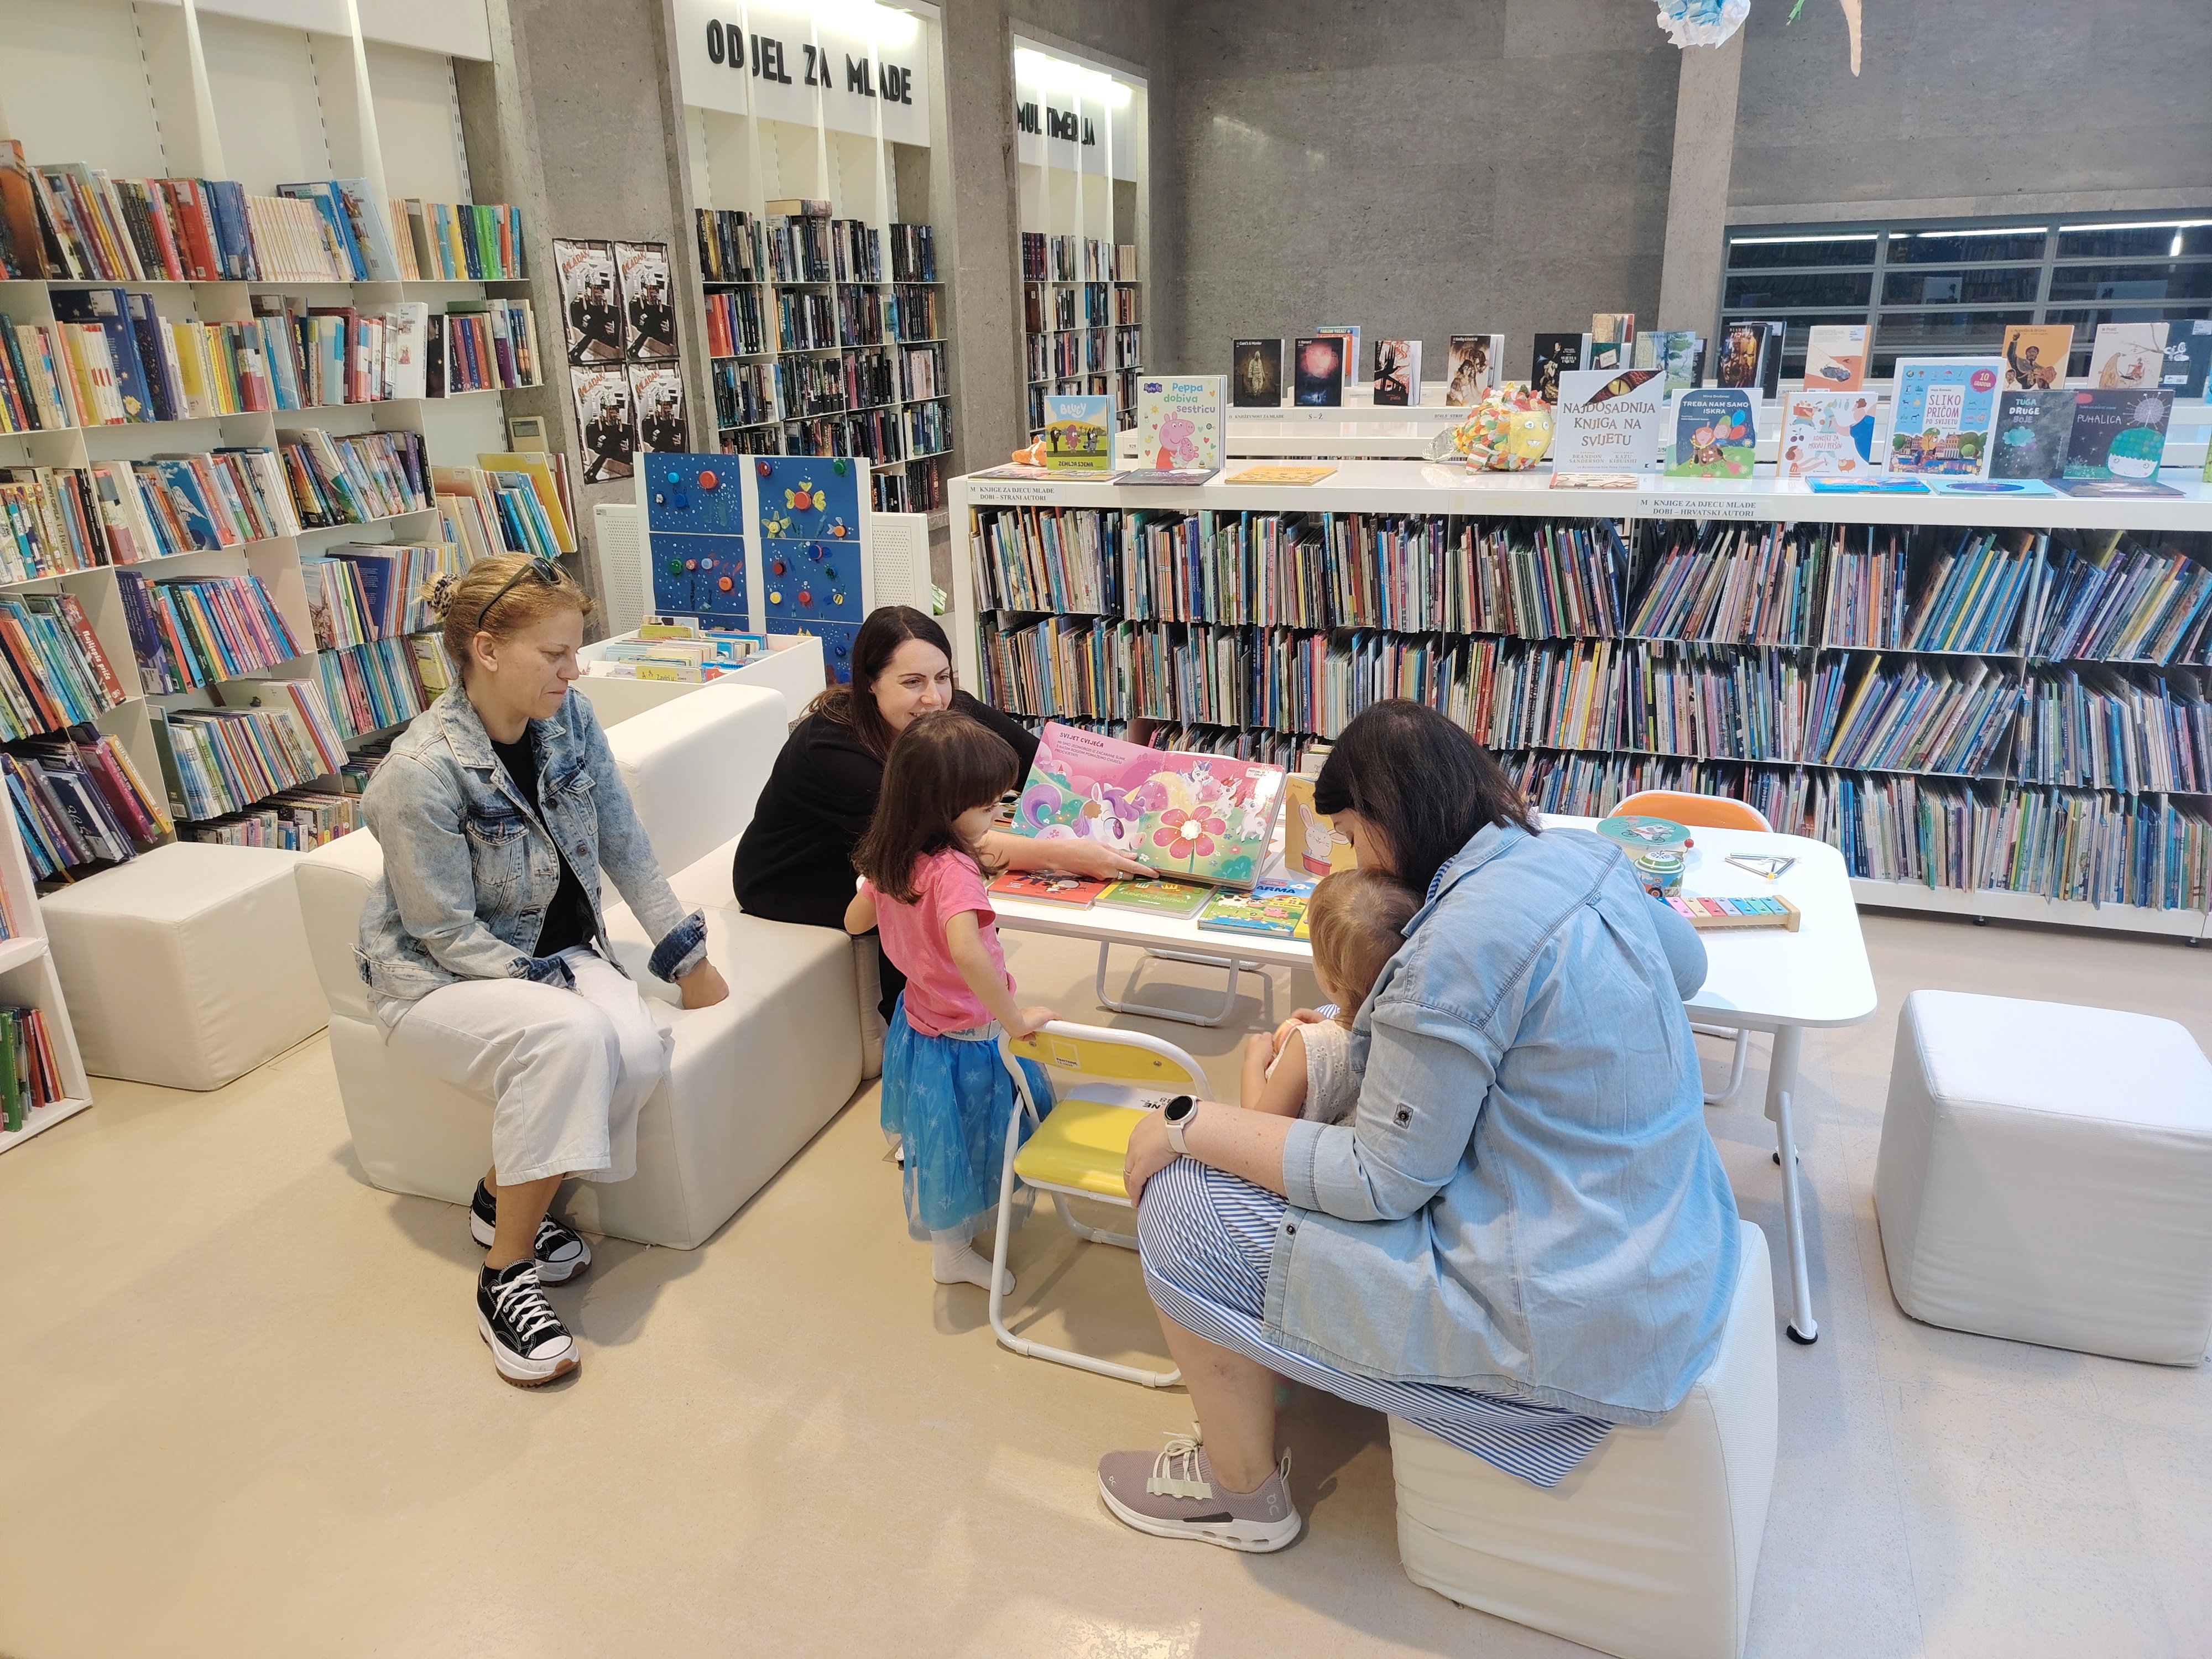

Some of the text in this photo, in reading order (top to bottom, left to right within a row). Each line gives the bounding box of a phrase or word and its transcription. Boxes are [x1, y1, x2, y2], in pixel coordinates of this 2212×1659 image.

[707, 19, 912, 105] ODJEL ZA MLADE
[1016, 101, 1095, 145] MULTIMEDJA
[1980, 373, 1990, 381] 10
[1172, 383, 1203, 393] Peppa
[1164, 394, 1198, 403] dobiva
[1929, 394, 1961, 405] SLIKO
[1176, 405, 1215, 413] sestricu
[1563, 402, 1655, 414] NAJDOSADNIJA
[1926, 406, 1959, 418] PRIČOM
[2009, 406, 2040, 415] DRUGE
[1574, 417, 1641, 430] KNJIGA NA
[2013, 415, 2033, 424] BOJE
[2077, 414, 2121, 425] PUHALICA
[1582, 434, 1631, 446] SVIJETU
[83, 630, 111, 681] Najljepše priče
[1060, 732, 1104, 748] SVIJET CVIJEĆA
[1256, 885, 1296, 894] ARMA
[1119, 891, 1151, 899] KARNEVAL
[1152, 894, 1187, 904] ŽIVOTINJA
